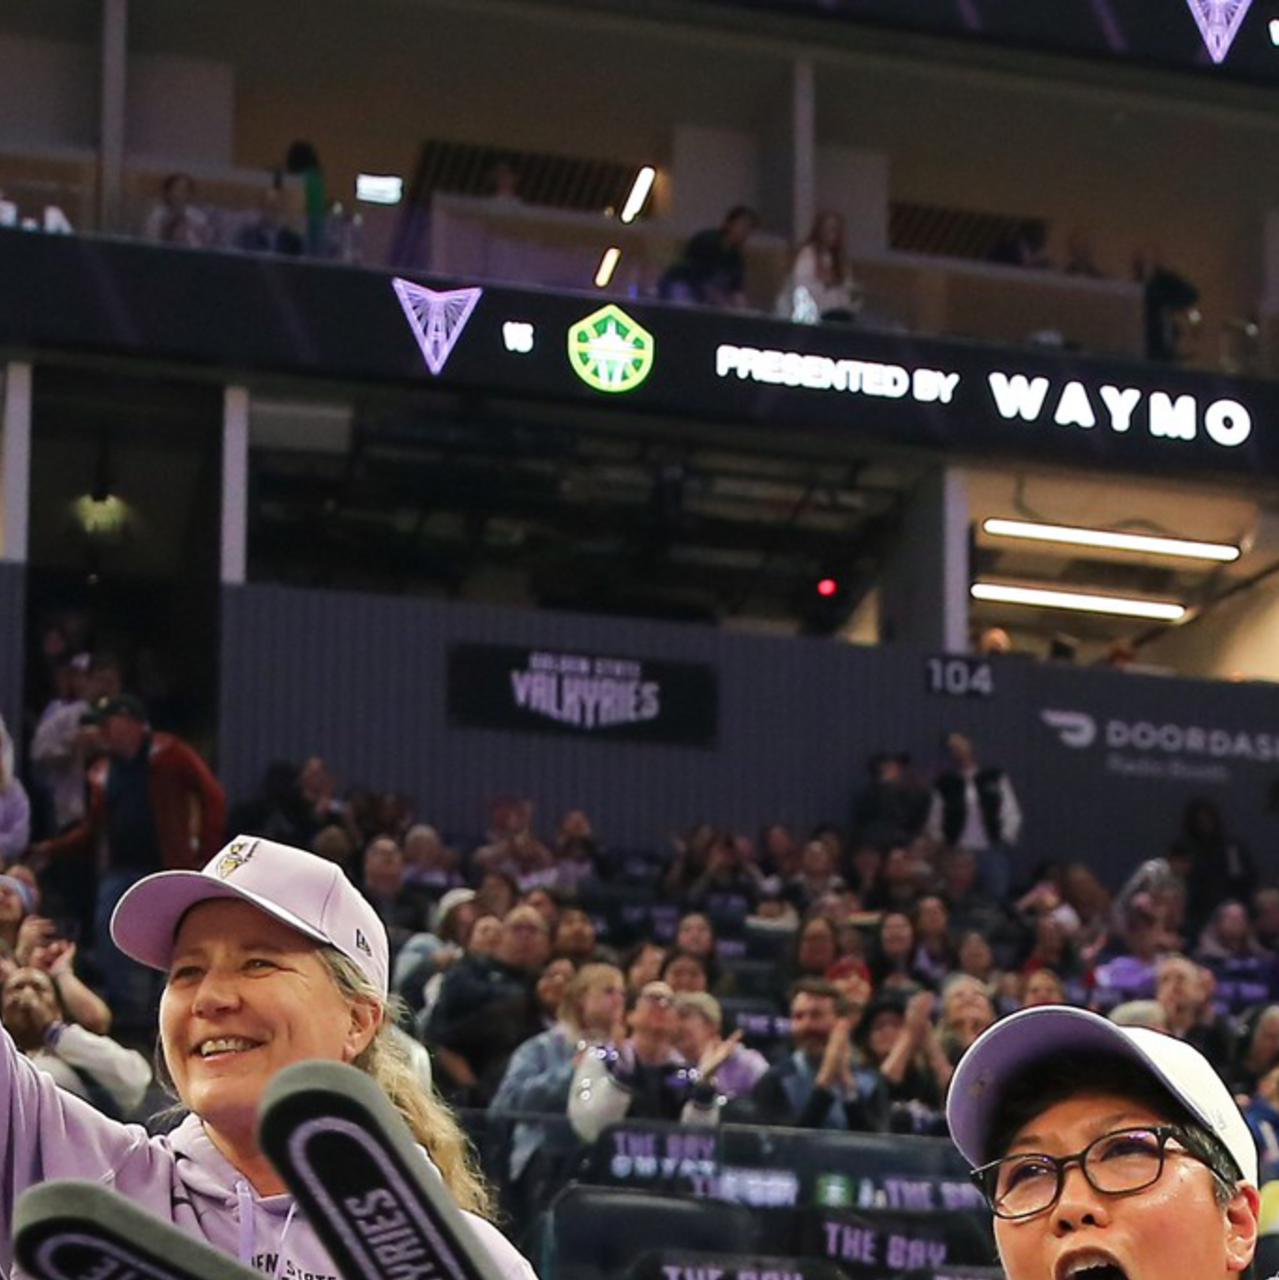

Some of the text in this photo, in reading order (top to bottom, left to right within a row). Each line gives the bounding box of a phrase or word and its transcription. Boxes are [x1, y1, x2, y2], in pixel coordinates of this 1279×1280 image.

[716, 344, 961, 404] PRESENTED BY
[988, 372, 1252, 447] WAYMO
[510, 668, 661, 729] VALKYRIES
[928, 658, 994, 695] 104
[825, 1222, 947, 1271] THE BAY
